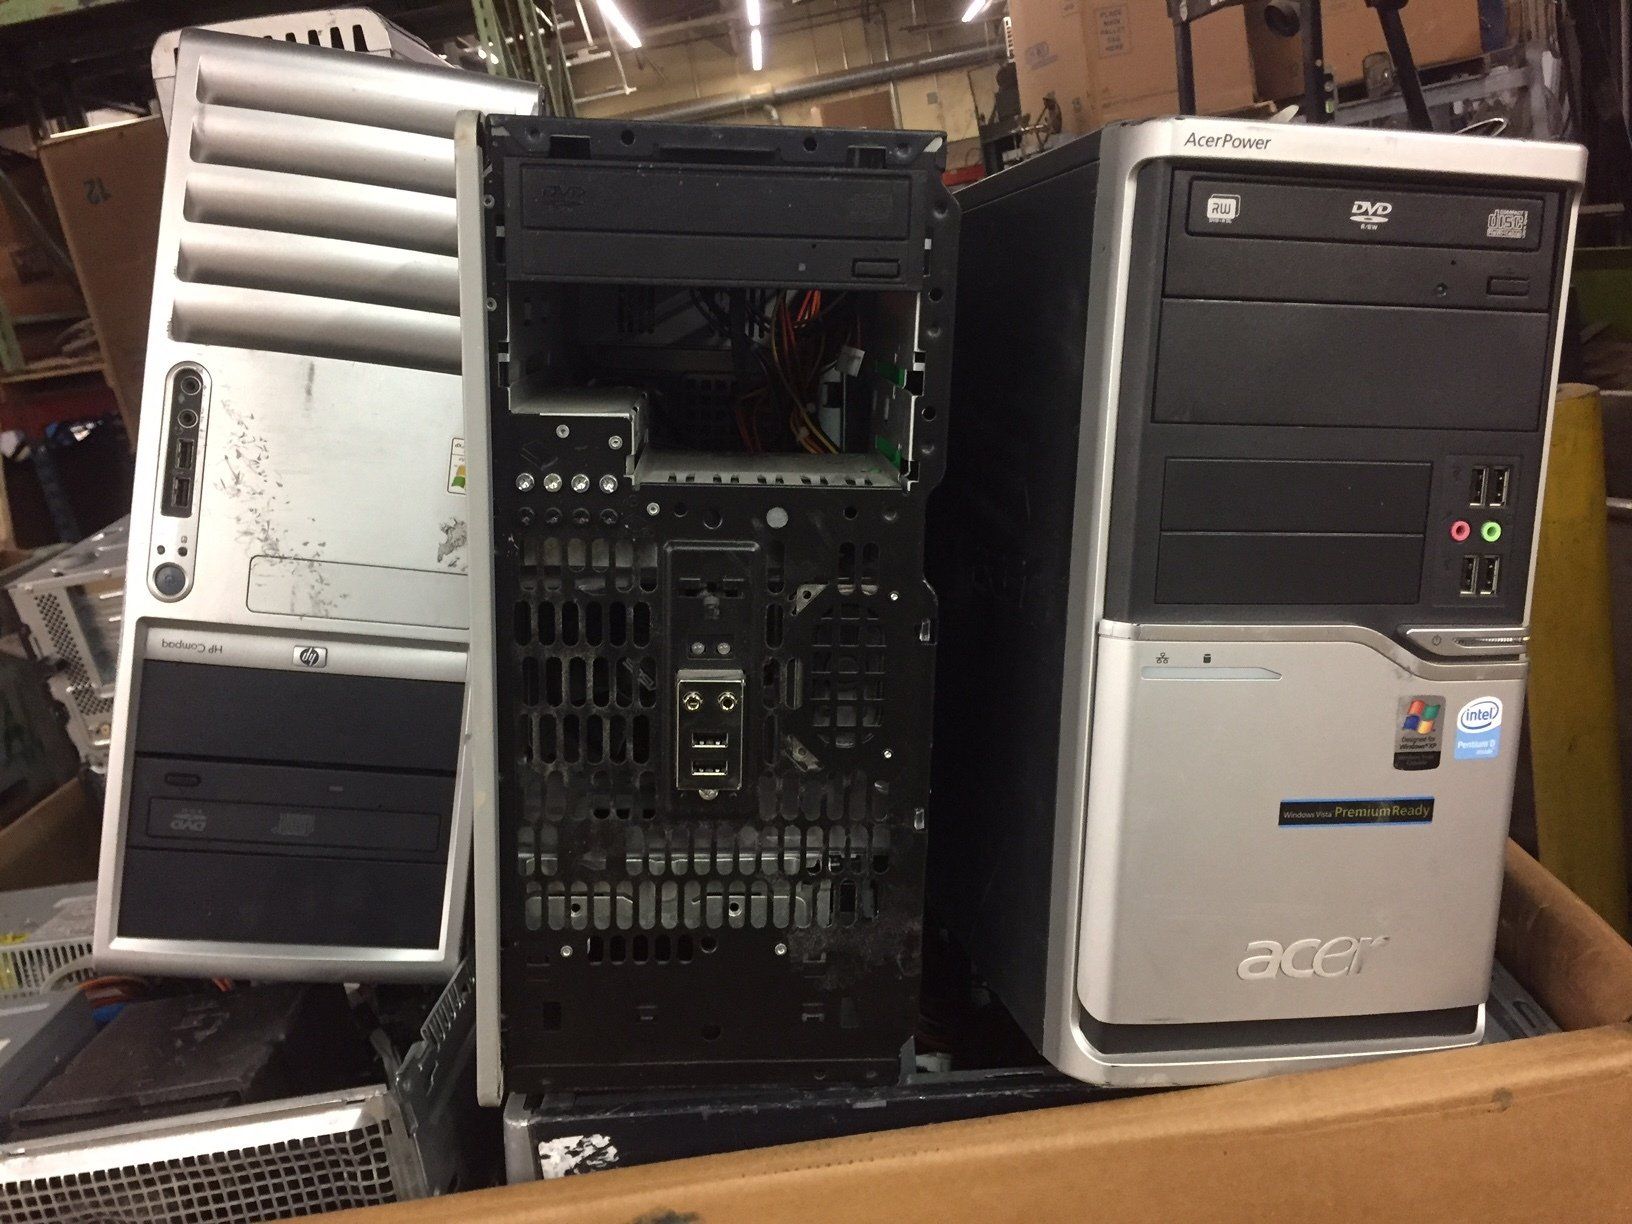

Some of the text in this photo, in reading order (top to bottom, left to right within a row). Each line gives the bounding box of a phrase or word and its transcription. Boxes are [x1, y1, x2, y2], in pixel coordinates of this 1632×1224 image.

[1184, 132, 1272, 150] AcerPower
[1211, 202, 1232, 215] RW
[1351, 200, 1393, 216] DVD
[161, 638, 223, 655] HP Compaq
[1466, 707, 1494, 721] intel
[1283, 810, 1315, 819] Windows
[1315, 810, 1333, 819] Vista
[1237, 936, 1390, 981] acer
